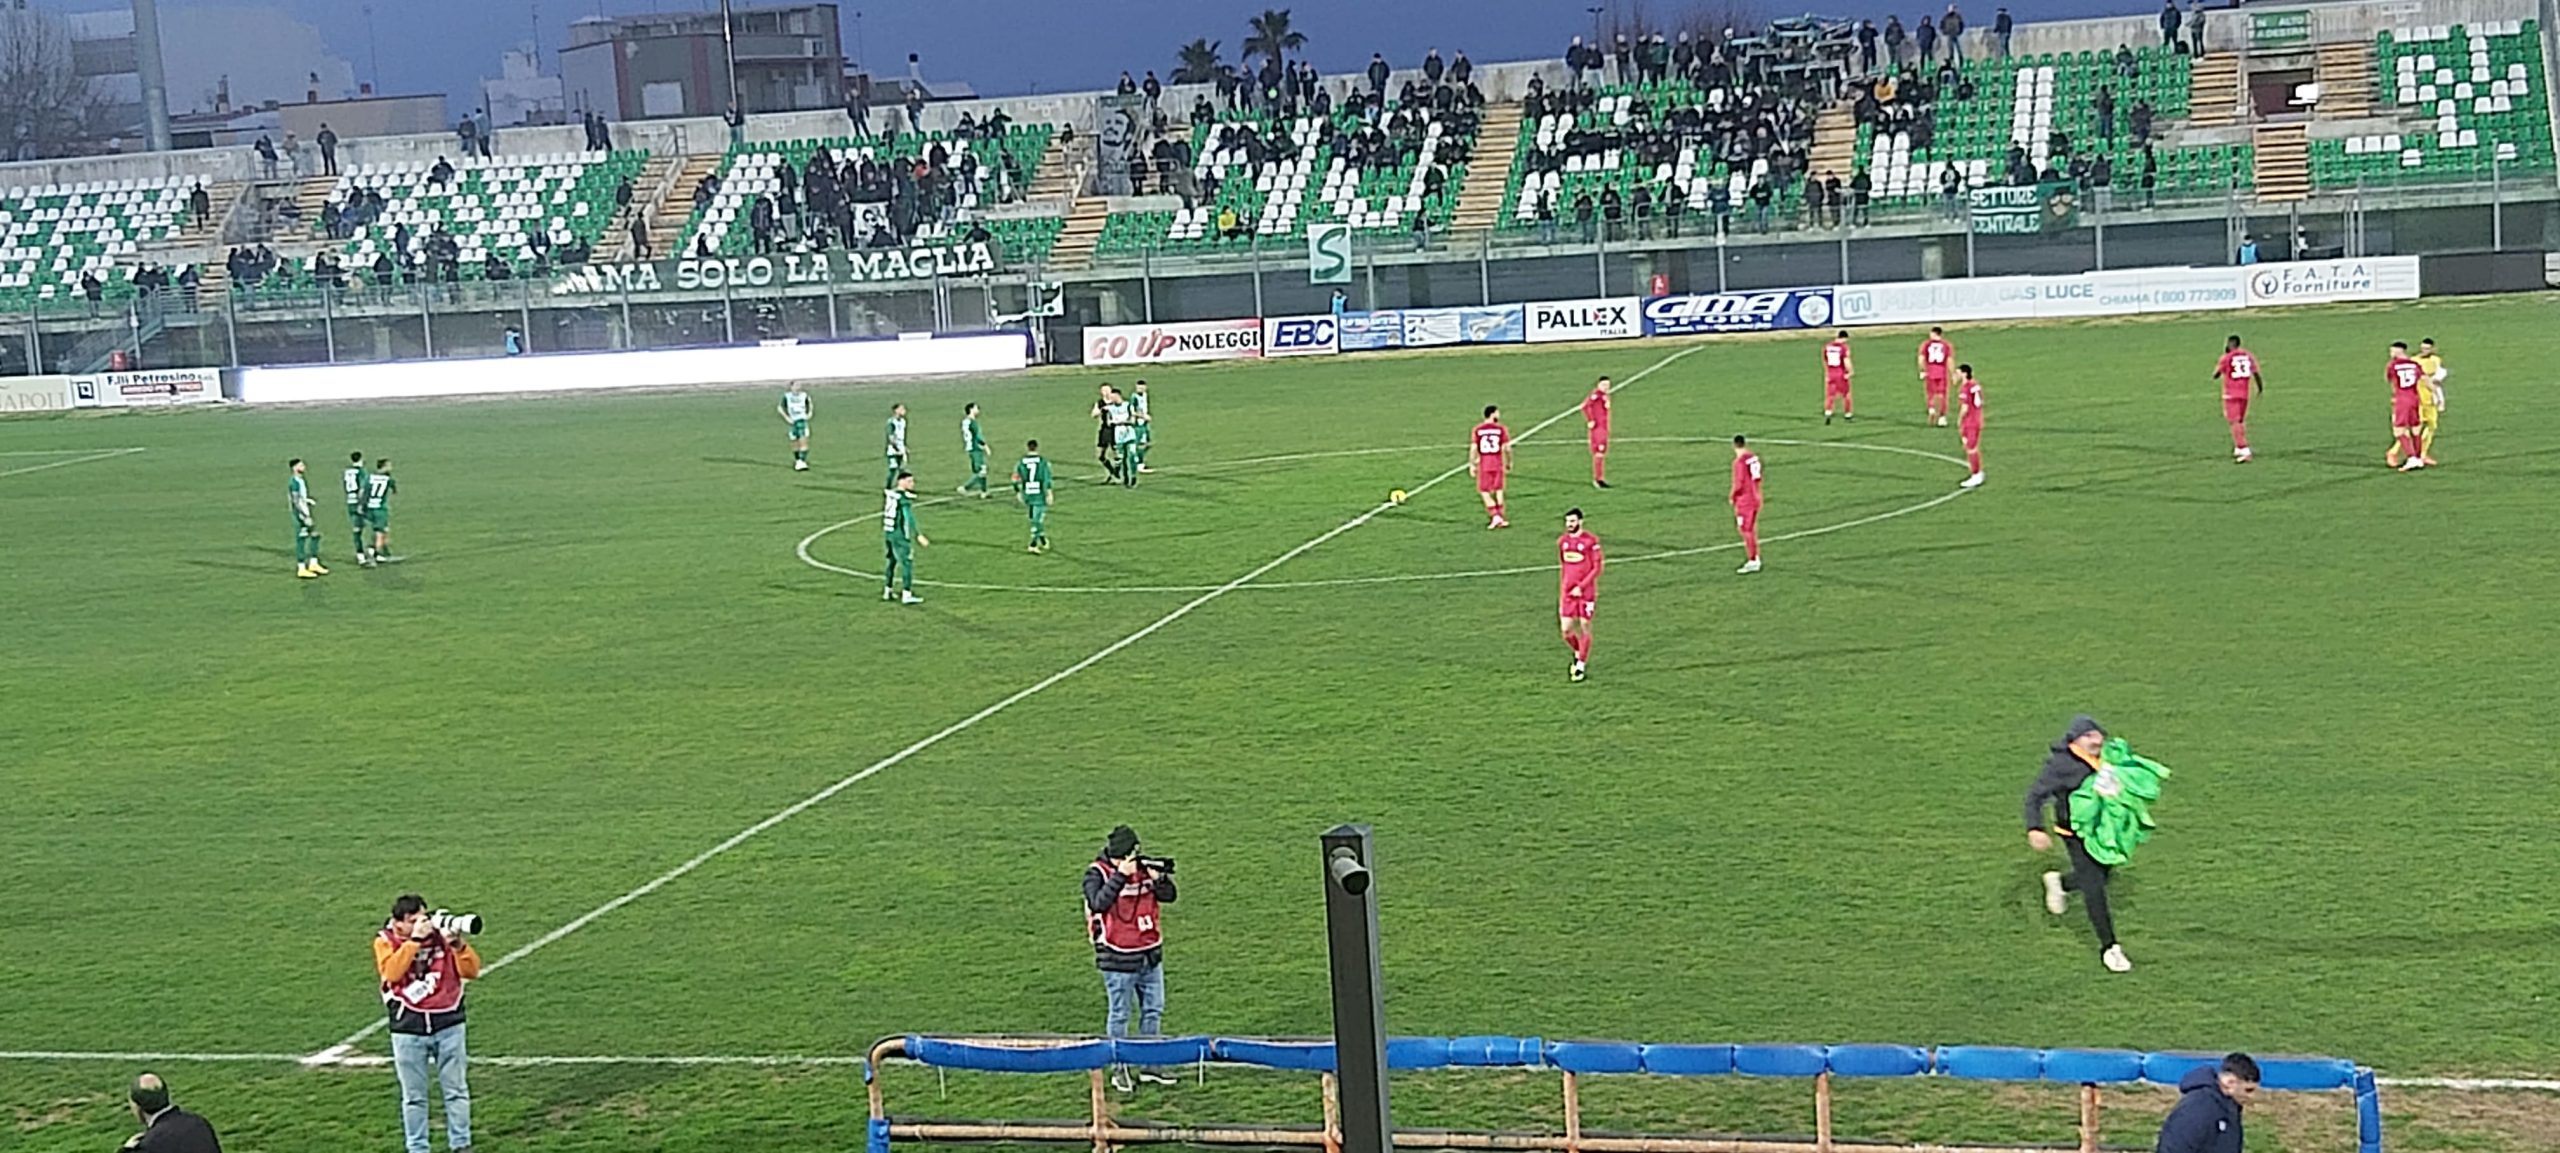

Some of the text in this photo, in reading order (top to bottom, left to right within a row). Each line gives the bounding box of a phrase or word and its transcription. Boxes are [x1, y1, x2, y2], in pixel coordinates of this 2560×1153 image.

[1969, 185, 2038, 206] SETTORE
[1971, 213, 2041, 234] CENTRALE
[677, 256, 773, 290] SOLO
[785, 253, 829, 282] LA
[848, 241, 995, 281] MAGLIA
[2044, 283, 2094, 300] LUCE
[2283, 278, 2371, 294] Forniture
[2100, 293, 2149, 306] CHIAMA
[1537, 305, 1627, 329] PALLEX
[1090, 327, 1259, 360] GO UP NOLEGGI
[1273, 319, 1335, 348] EBC
[133, 372, 195, 384] Petrosino
[2231, 359, 2251, 379] 33
[0, 391, 66, 411] APOLI
[1480, 434, 1501, 454] 63
[1026, 463, 1037, 483] 7
[370, 481, 388, 498] 77
